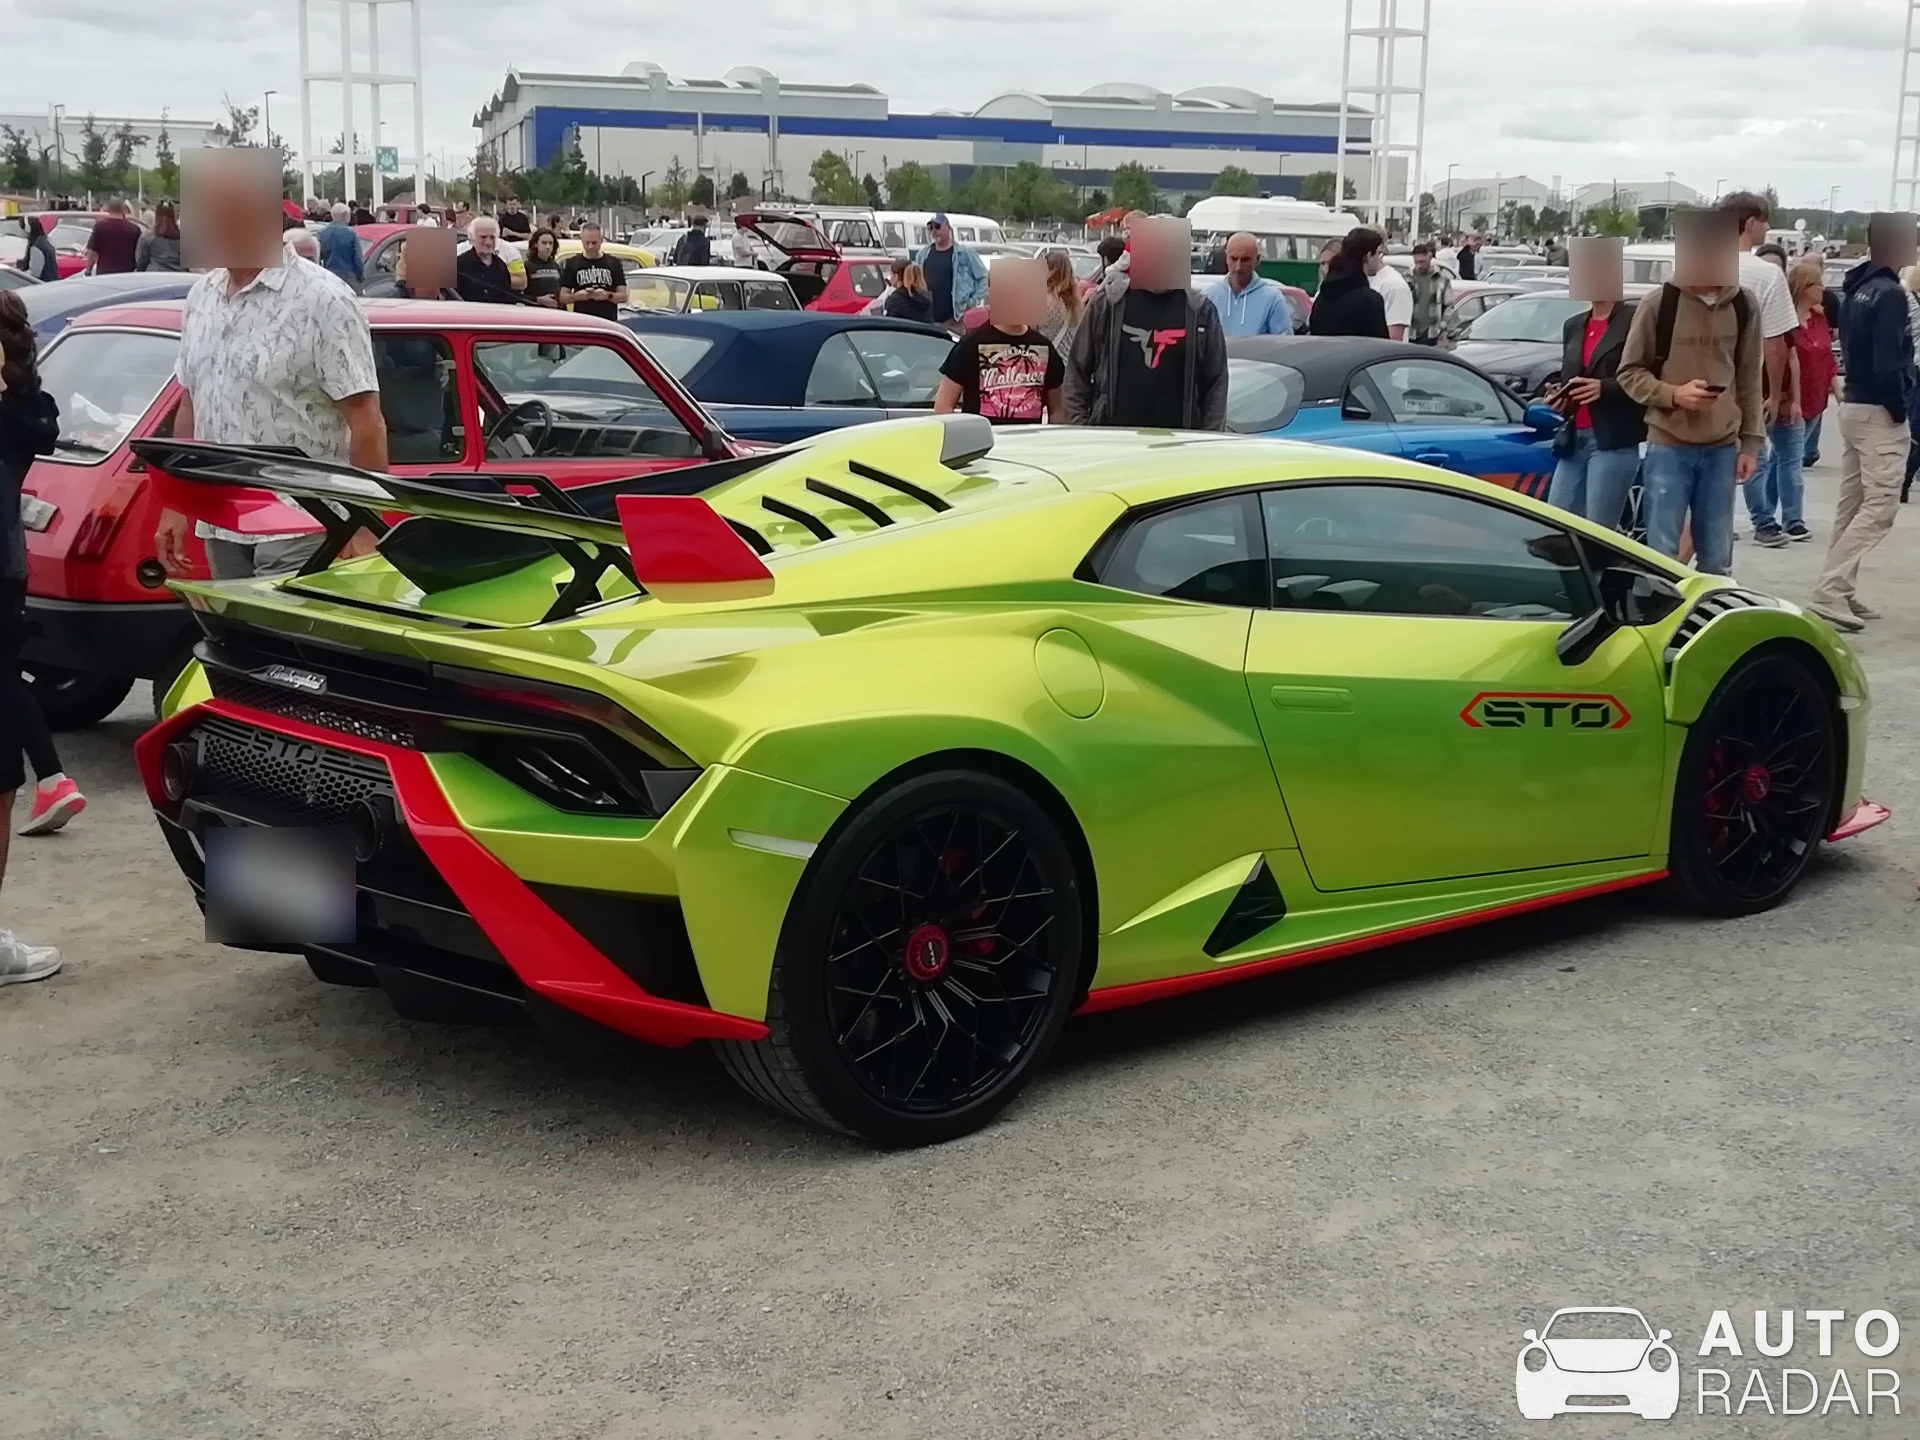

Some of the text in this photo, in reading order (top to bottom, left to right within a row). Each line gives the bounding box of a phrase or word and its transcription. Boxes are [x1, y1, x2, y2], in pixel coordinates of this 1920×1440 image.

[981, 366, 1044, 388] Mallorca
[1484, 701, 1610, 728] STO
[252, 730, 319, 766] STO
